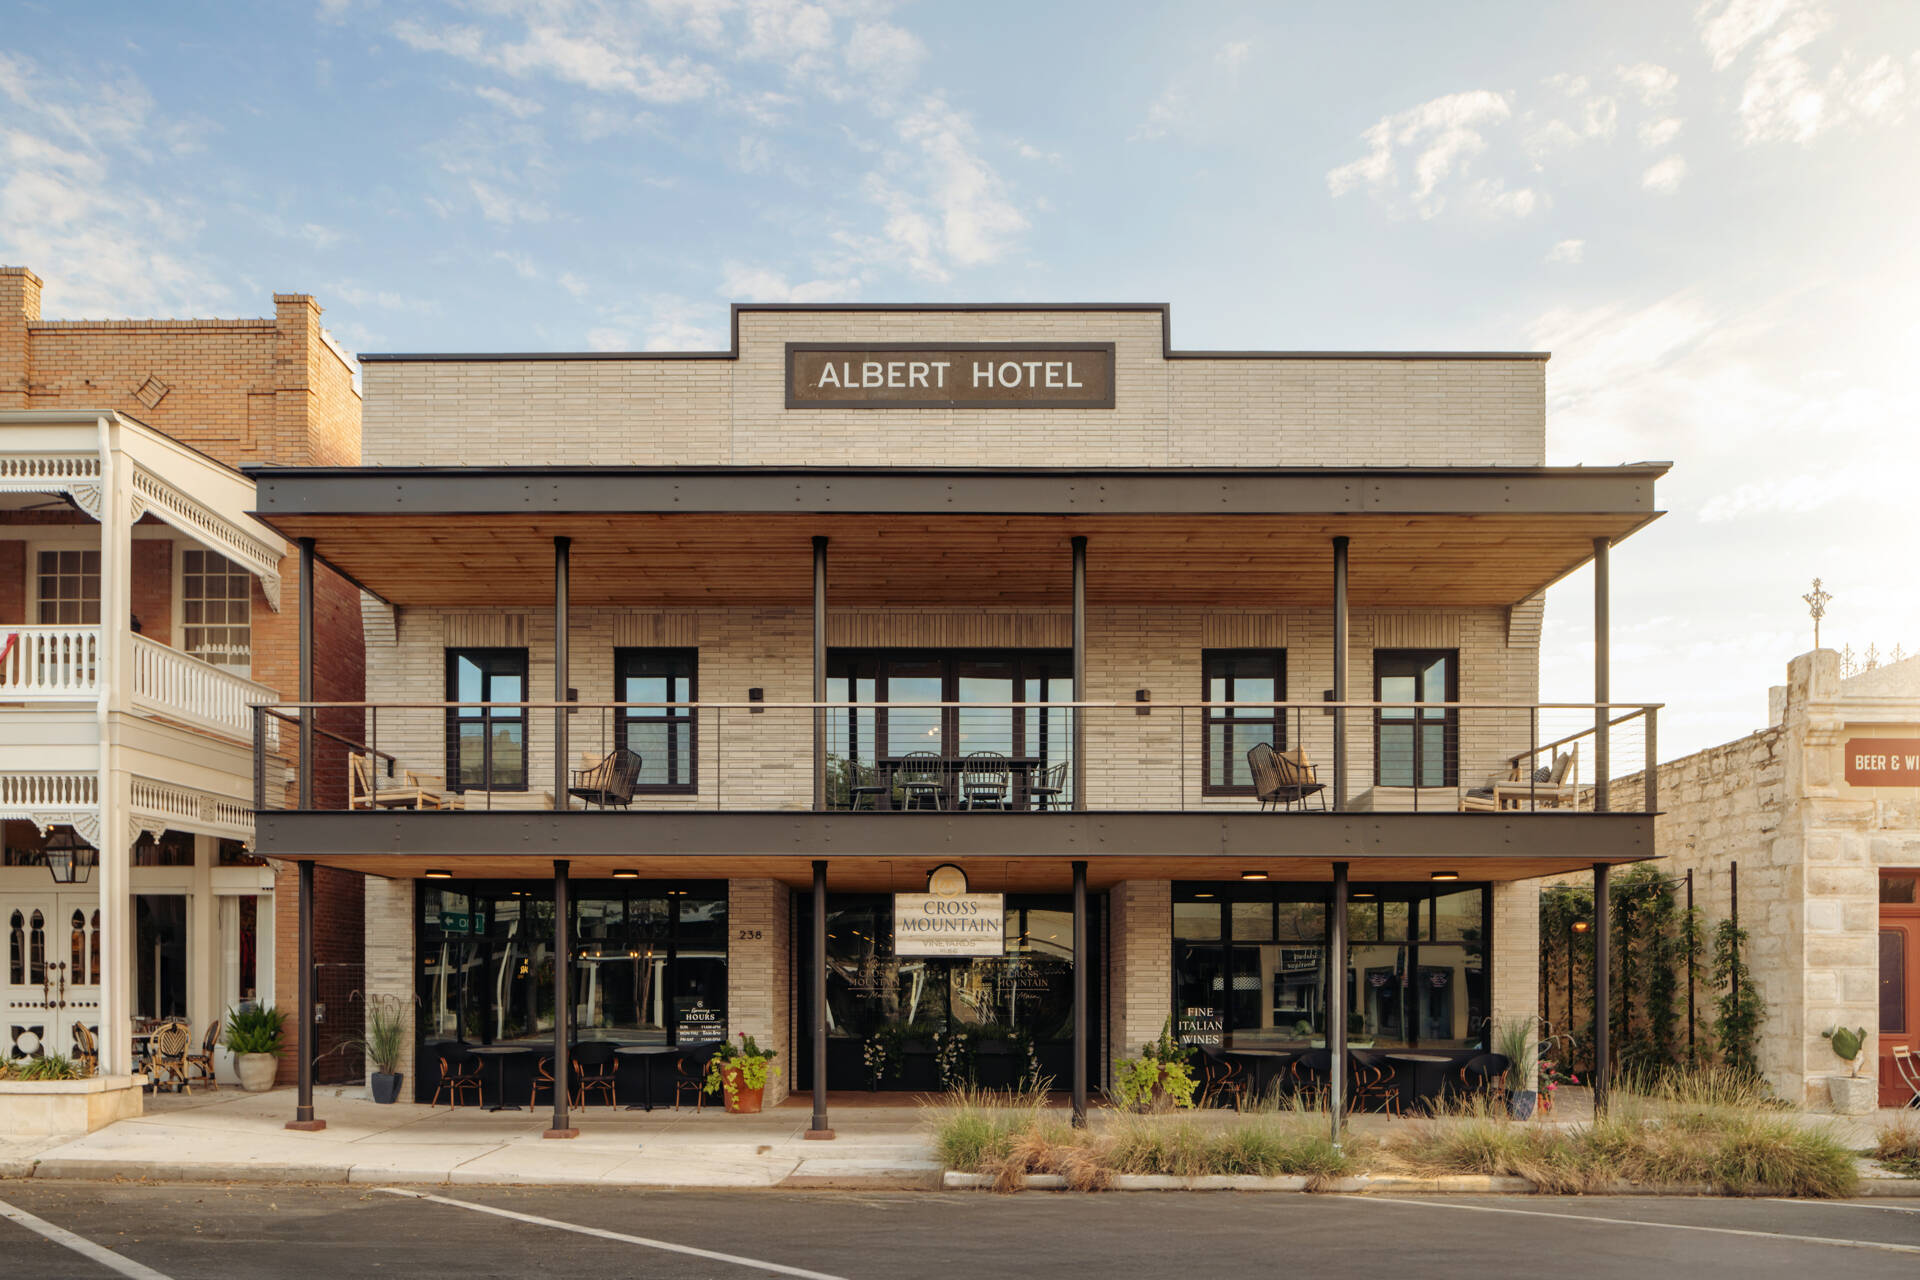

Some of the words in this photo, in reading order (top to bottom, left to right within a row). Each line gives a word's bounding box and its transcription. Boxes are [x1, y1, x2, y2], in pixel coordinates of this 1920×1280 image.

[818, 362, 950, 388] ALBERT
[973, 362, 1083, 388] HOTEL
[1855, 755, 1886, 770] BEER
[1891, 755, 1900, 770] &
[924, 901, 977, 915] CROSS
[902, 918, 999, 932] MOUNTAIN
[738, 930, 762, 940] 238
[921, 939, 976, 947] VINEYARDS
[1187, 1007, 1214, 1017] FINE
[1178, 1020, 1223, 1031] ITALIAN
[1182, 1034, 1219, 1044] WINES
